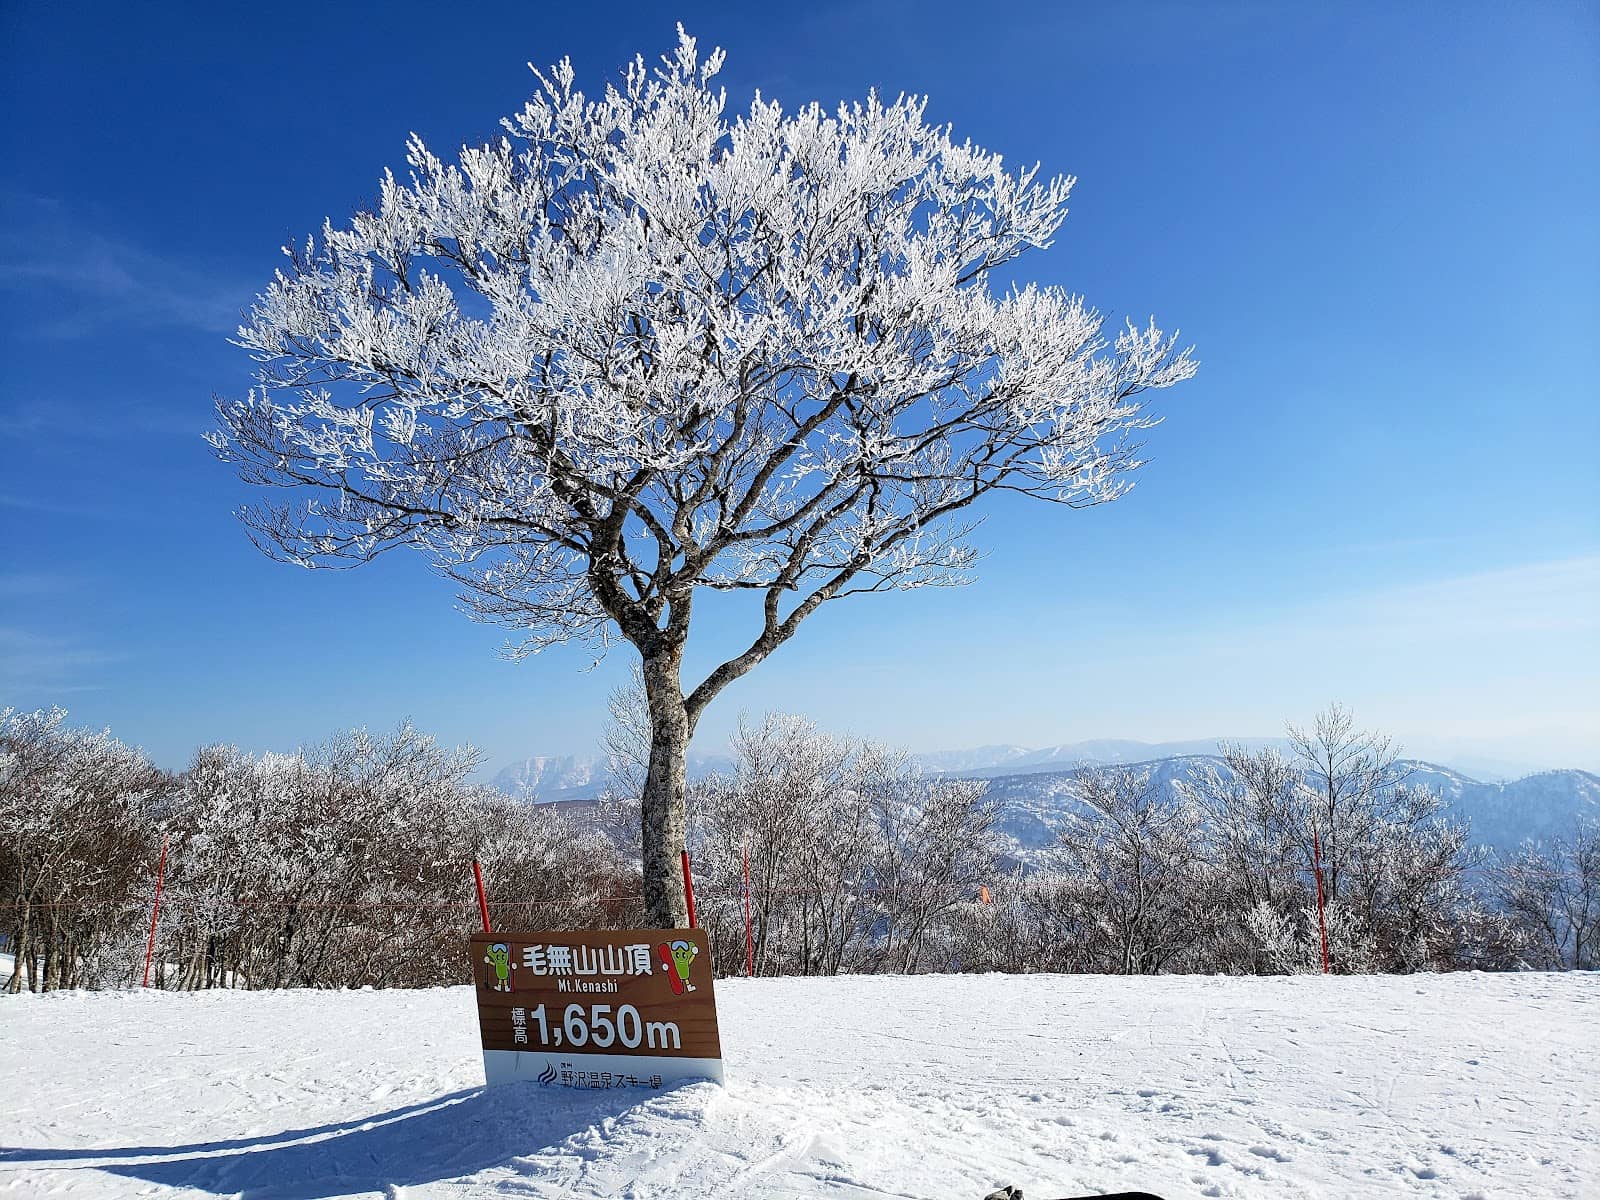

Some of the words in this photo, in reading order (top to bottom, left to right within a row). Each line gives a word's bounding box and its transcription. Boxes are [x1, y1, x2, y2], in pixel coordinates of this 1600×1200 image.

[522, 944, 653, 977] 毛無山山頂
[558, 979, 619, 994] Mt.Kenashi
[511, 1007, 528, 1045] 標高
[531, 1003, 682, 1050] 1,650m
[560, 1070, 663, 1090] 野沢温泉スキー場
